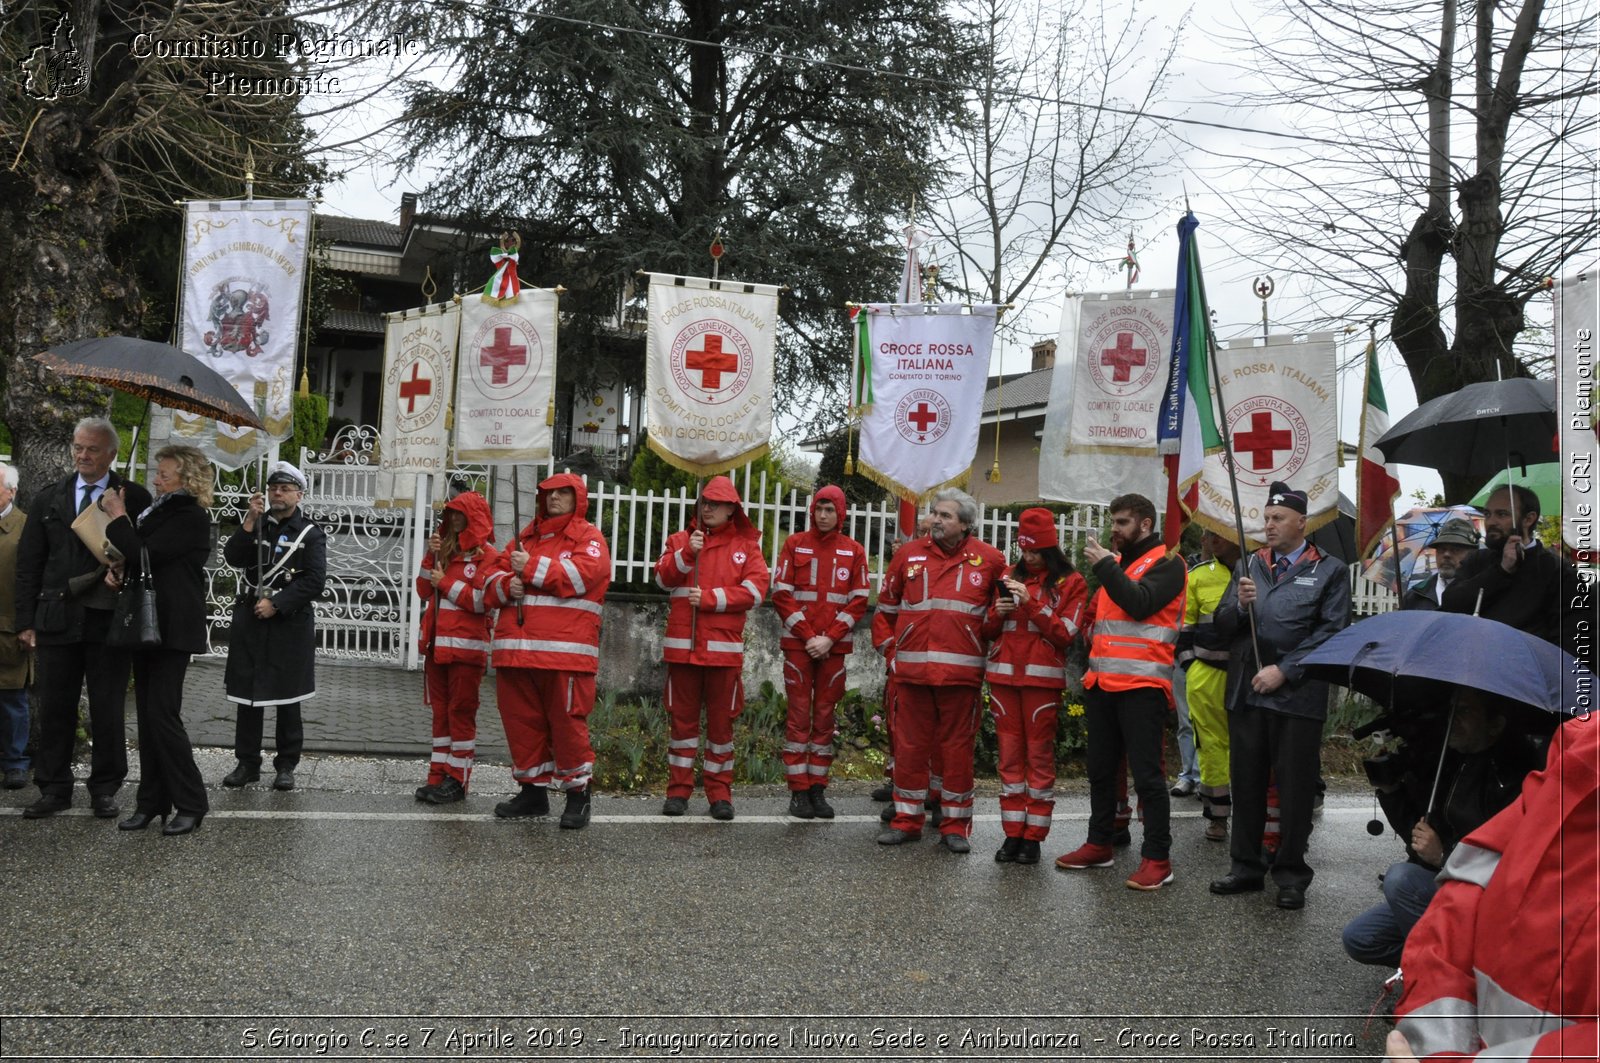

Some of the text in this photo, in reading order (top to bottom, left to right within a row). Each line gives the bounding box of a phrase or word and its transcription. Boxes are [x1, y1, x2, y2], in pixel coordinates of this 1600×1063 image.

[661, 296, 765, 331] CROCE ROSSA ITALIANA
[1084, 305, 1169, 338] CROCE ROSSA ITALIANA
[880, 342, 974, 356] CROCE ROSSA
[1112, 321, 1143, 331] GINEVRA
[1142, 328, 1152, 338] 22
[1148, 337, 1159, 371] AGOSTO
[672, 321, 752, 394] CONVENZIONE DI GINEVRA 22 AGOSTO 1864
[897, 358, 954, 370] ITALIANA
[1233, 363, 1330, 403] ROSSA ITALIANA
[469, 408, 541, 418] COMITATO LOCALE
[656, 386, 761, 428] COMITATO LOCALE DI
[1087, 401, 1154, 412] COMITATO LOCALE
[494, 421, 503, 430] DI
[1113, 413, 1119, 422] DI
[1168, 412, 1178, 431] SEZ.
[650, 424, 673, 438] SAN
[675, 427, 728, 442] GIORGIO
[1088, 426, 1147, 439] STRAMBINO
[1233, 398, 1308, 473] DI GINEVRA 22 AGOSTO 1864
